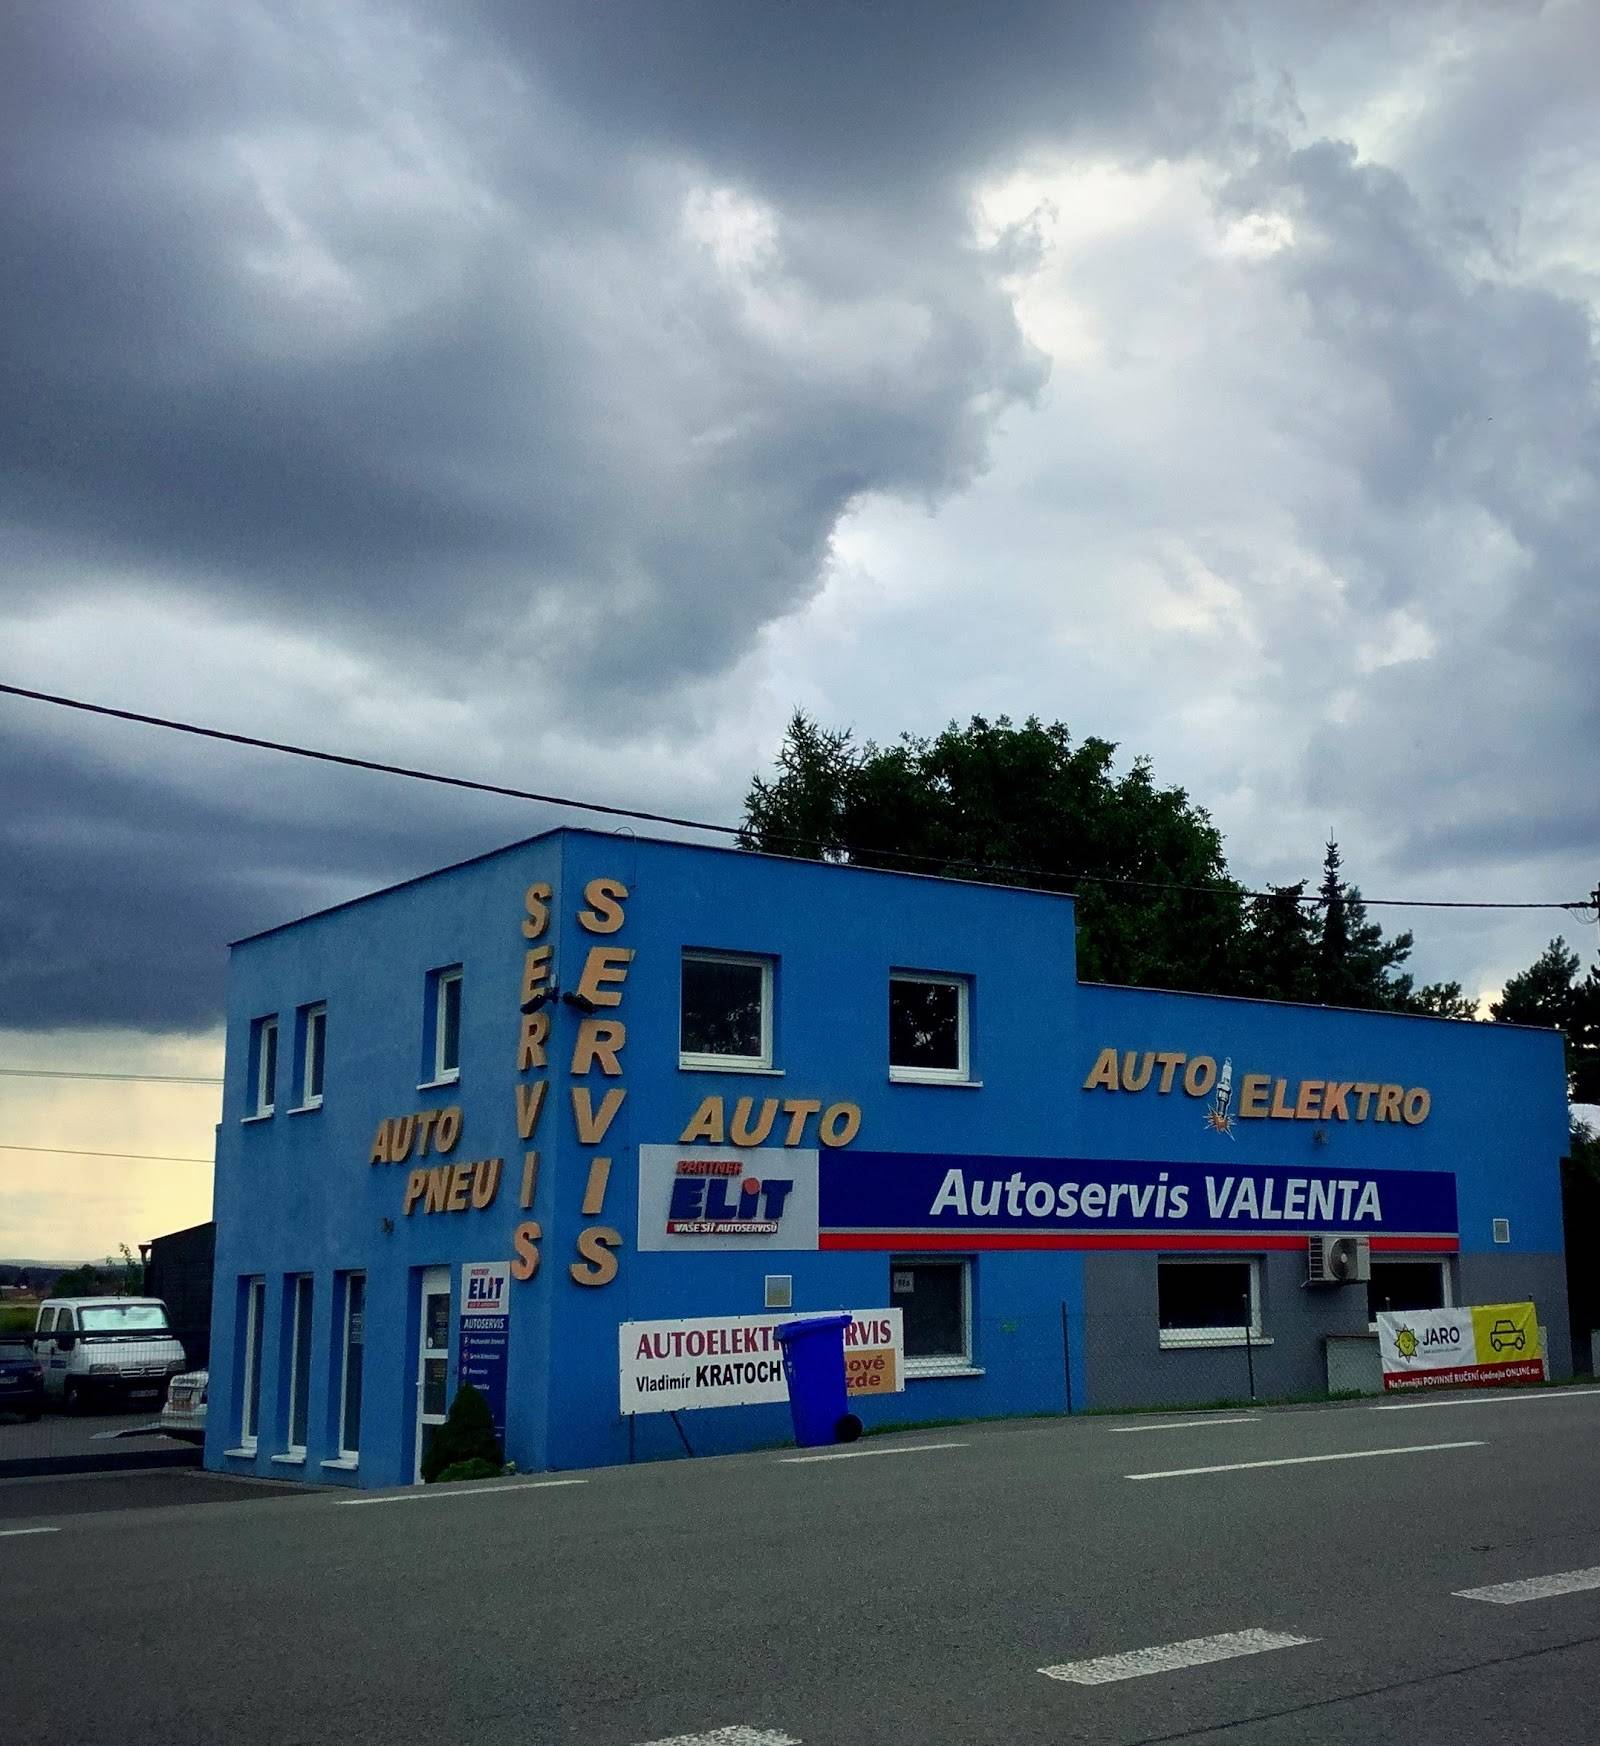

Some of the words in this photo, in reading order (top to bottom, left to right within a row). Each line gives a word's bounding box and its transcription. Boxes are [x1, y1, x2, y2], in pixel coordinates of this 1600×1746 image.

[511, 882, 553, 1281] SERVIS
[571, 878, 636, 1286] SERVIS
[1082, 1048, 1217, 1098] AUTO
[1238, 1074, 1432, 1126] ELEKTRO
[370, 1106, 463, 1164] AUTO
[680, 1095, 862, 1148] AUTO
[403, 1157, 503, 1216] PNEU
[929, 1168, 1190, 1219] Autoservis
[1205, 1176, 1383, 1222] VALENTA
[463, 1318, 504, 1330] AUTOSERVIS
[844, 1319, 892, 1346] RVIS
[1422, 1326, 1461, 1346] JARO
[636, 1373, 691, 1393] Vladimír
[695, 1360, 782, 1388] KRATOCH
[1423, 1372, 1454, 1386] POVINNÉ
[1454, 1370, 1480, 1384] RUČENÍ
